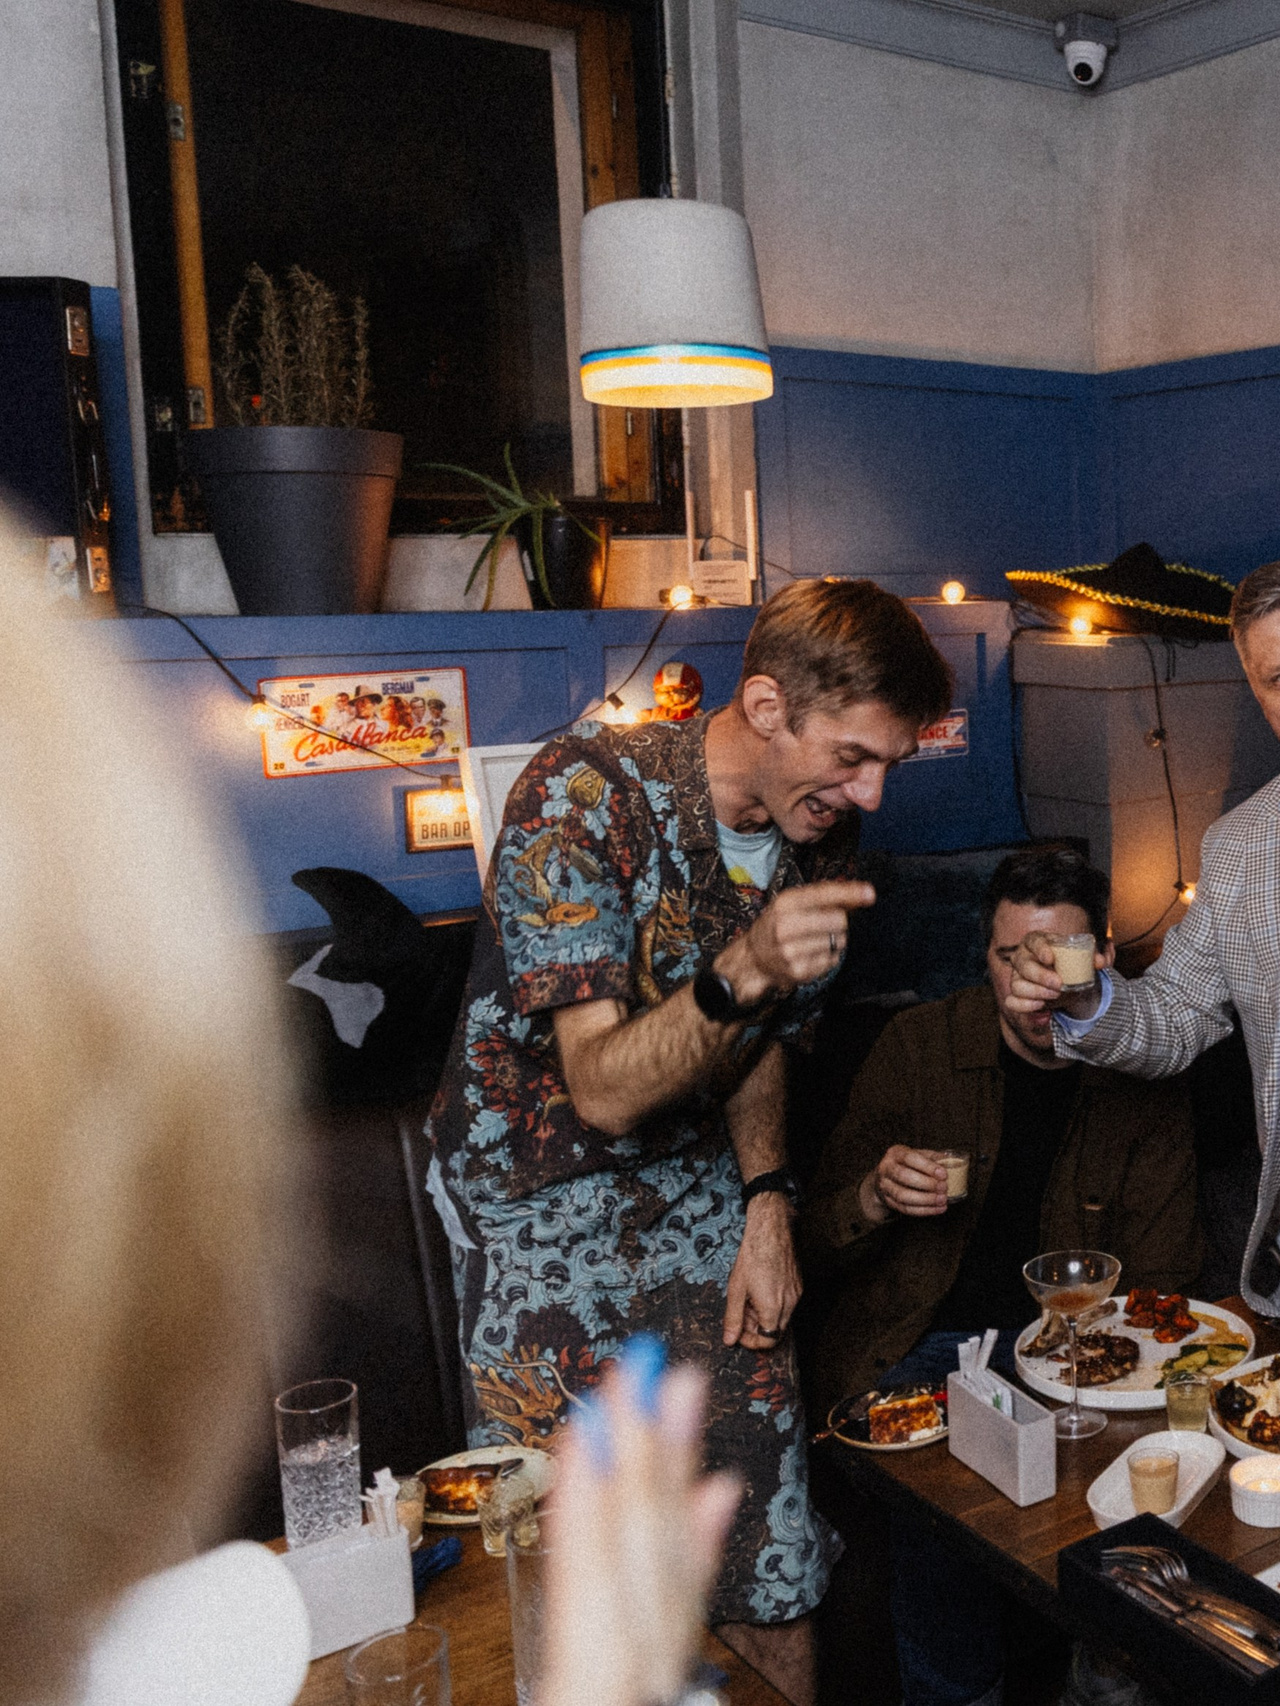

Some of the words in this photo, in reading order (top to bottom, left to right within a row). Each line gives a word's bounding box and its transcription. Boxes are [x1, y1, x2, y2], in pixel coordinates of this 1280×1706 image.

[294, 721, 429, 763] Casablanca
[421, 822, 448, 840] BAR
[453, 820, 471, 837] OP
